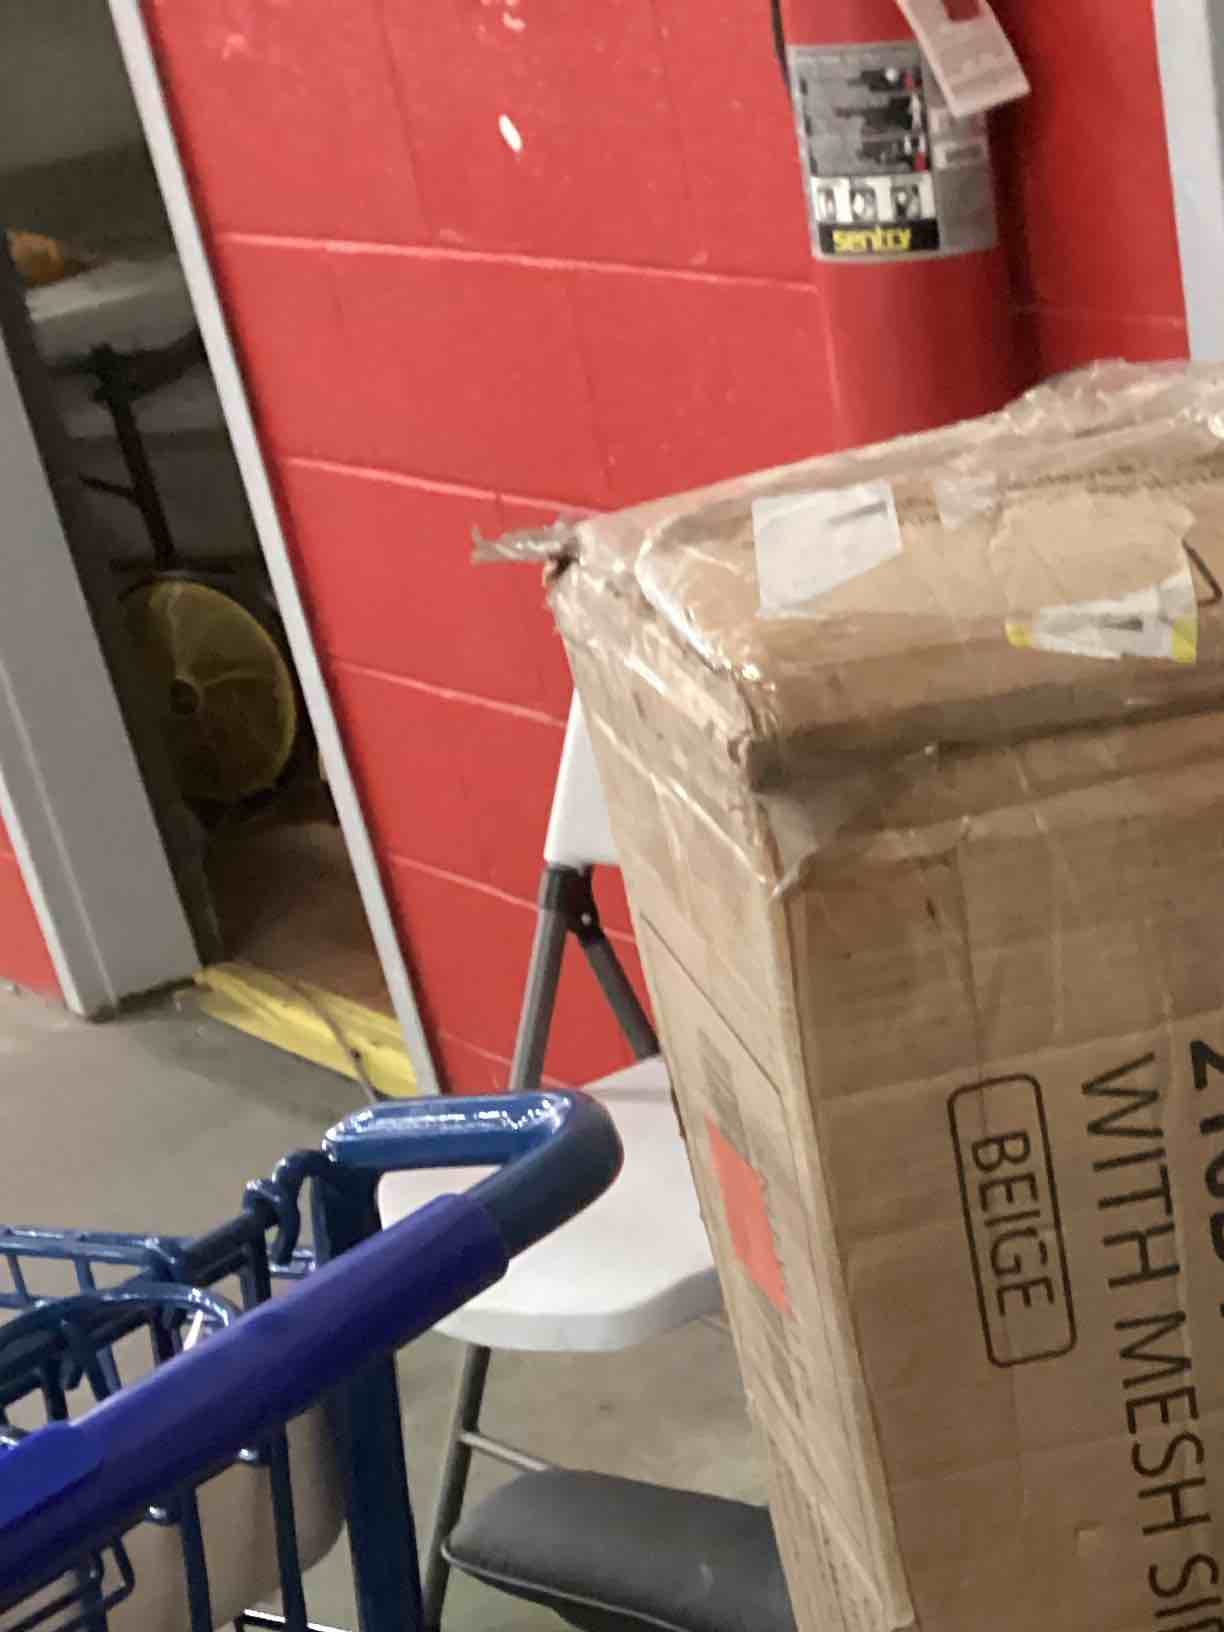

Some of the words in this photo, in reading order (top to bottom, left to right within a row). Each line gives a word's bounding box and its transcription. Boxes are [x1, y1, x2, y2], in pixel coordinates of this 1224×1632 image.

[832, 226, 912, 252] sentry
[971, 1130, 1055, 1318] BEIGE
[1081, 1053, 1180, 1289] WITH
[1115, 1310, 1211, 1537] MESH
